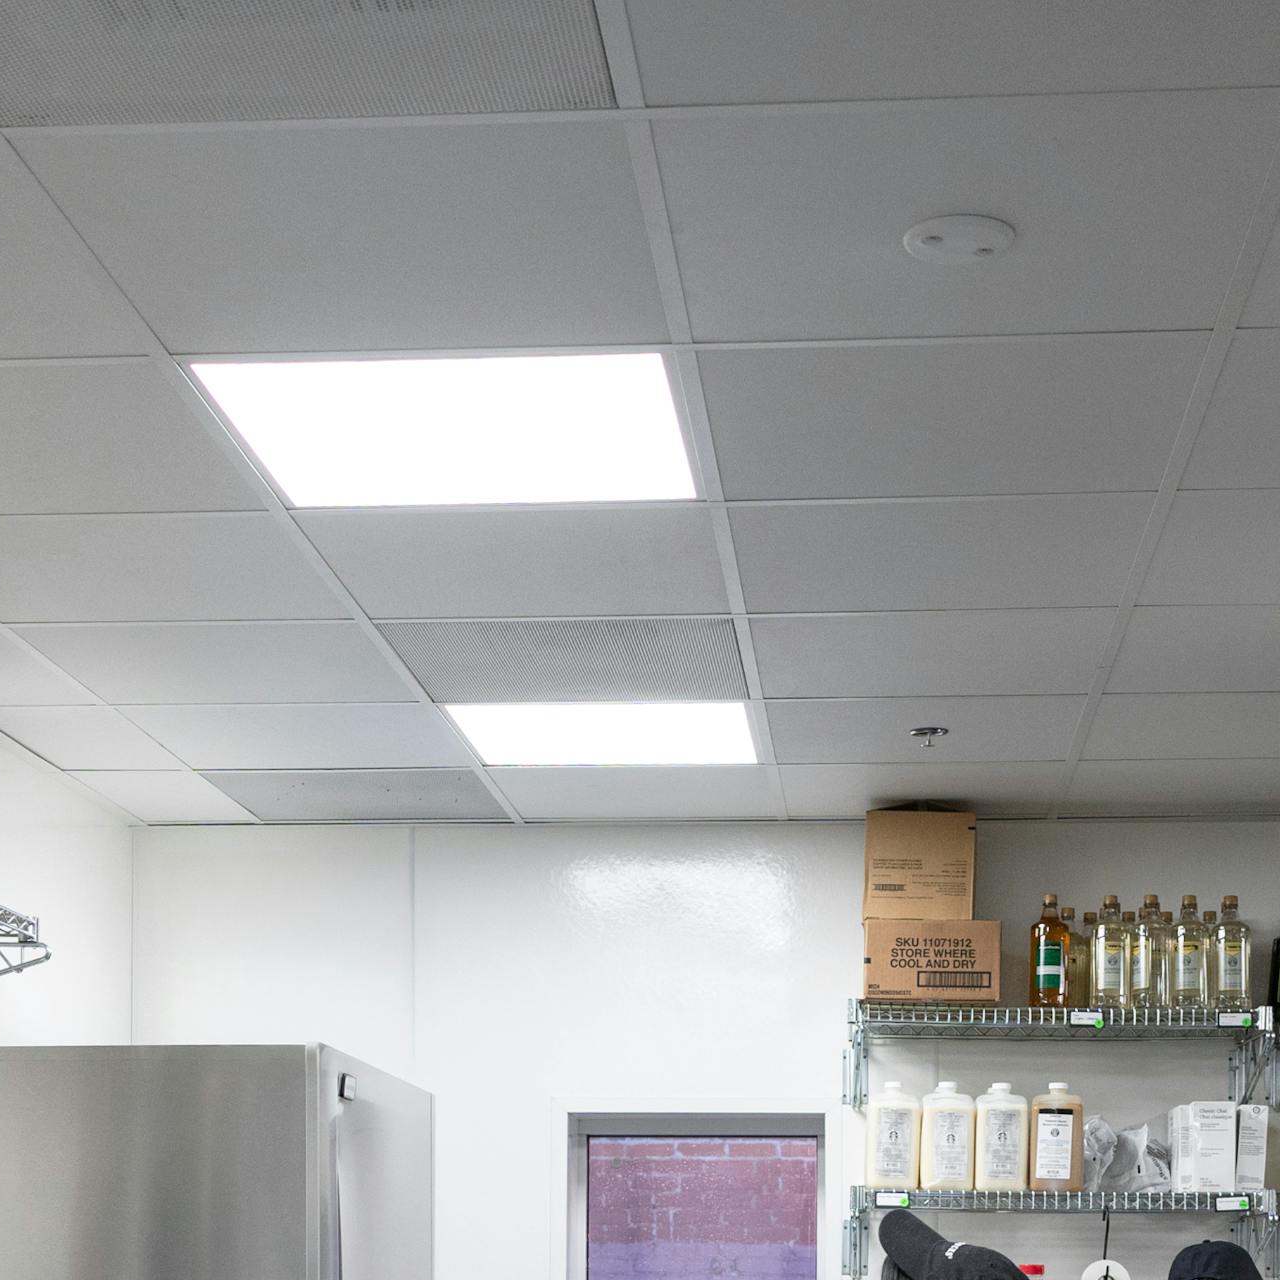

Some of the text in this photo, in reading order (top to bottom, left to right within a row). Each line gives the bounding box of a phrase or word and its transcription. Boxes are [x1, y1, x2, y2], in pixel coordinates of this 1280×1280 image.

[895, 937, 972, 948] SKU 11071912
[890, 949, 977, 959] STORE WHERE
[890, 959, 977, 969] COOL AND DRY
